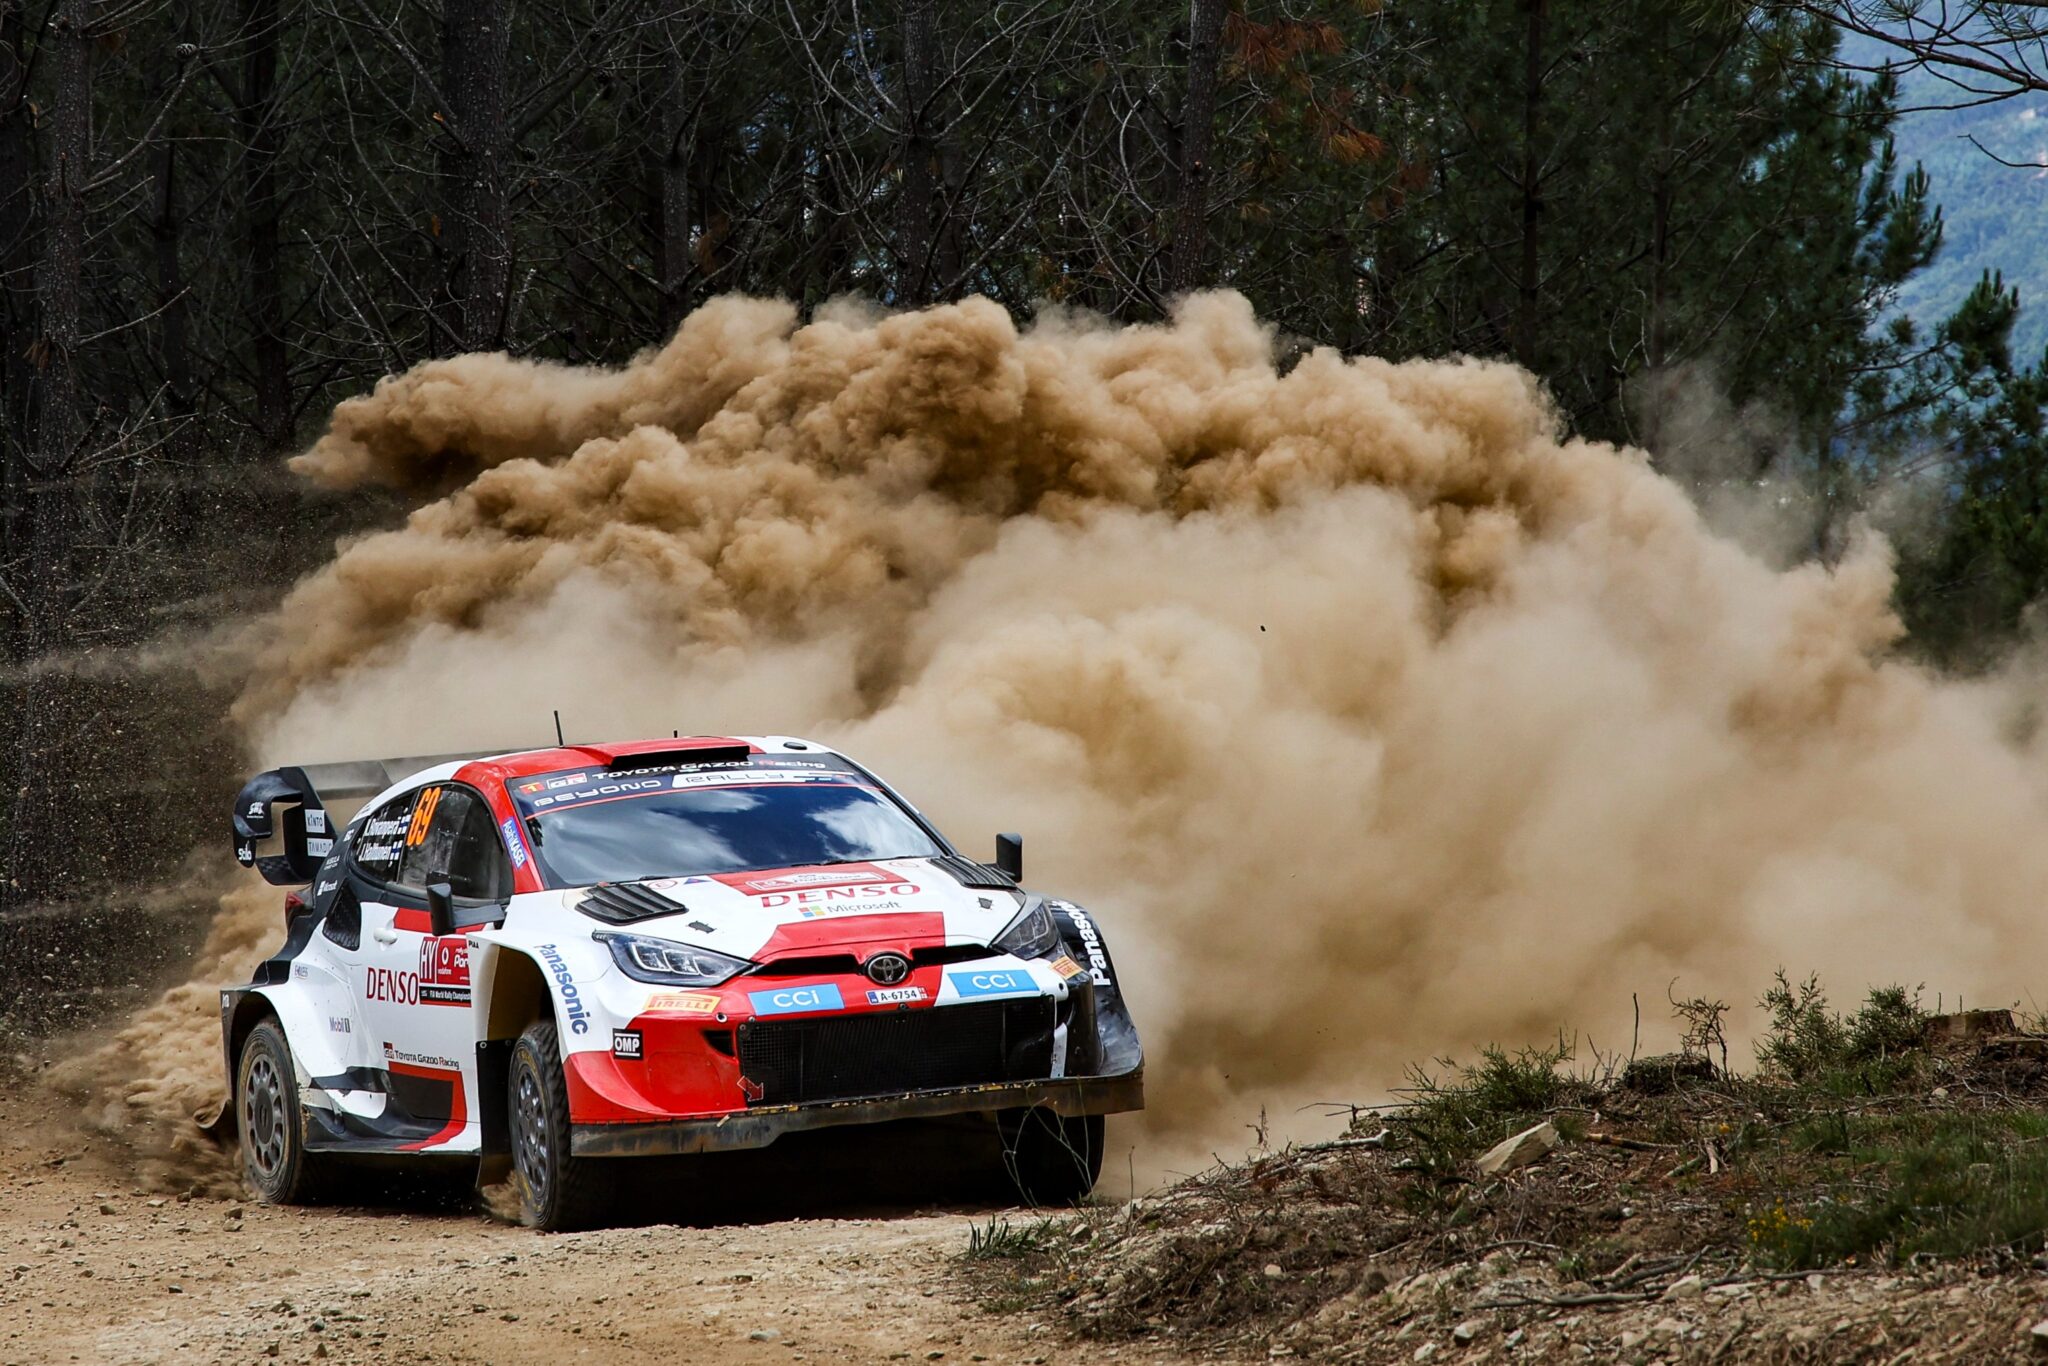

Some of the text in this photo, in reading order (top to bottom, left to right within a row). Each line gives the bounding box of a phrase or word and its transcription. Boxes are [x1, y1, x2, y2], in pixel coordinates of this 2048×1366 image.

[592, 759, 826, 780] TOYOTA GAZOO Racing
[534, 773, 784, 807] BEYOND RALLY
[407, 786, 441, 846] 69
[761, 884, 921, 908] DENSO
[827, 901, 902, 913] Microsoft
[366, 966, 419, 1006] DENSO
[533, 943, 591, 1035] Panasonic
[880, 989, 917, 1001] A-6754
[648, 995, 713, 1010] PIRELLI
[614, 1036, 640, 1053] OMP
[394, 1050, 417, 1062] TOYOTA
[418, 1053, 439, 1065] GAZOO
[439, 1056, 460, 1071] Racing
